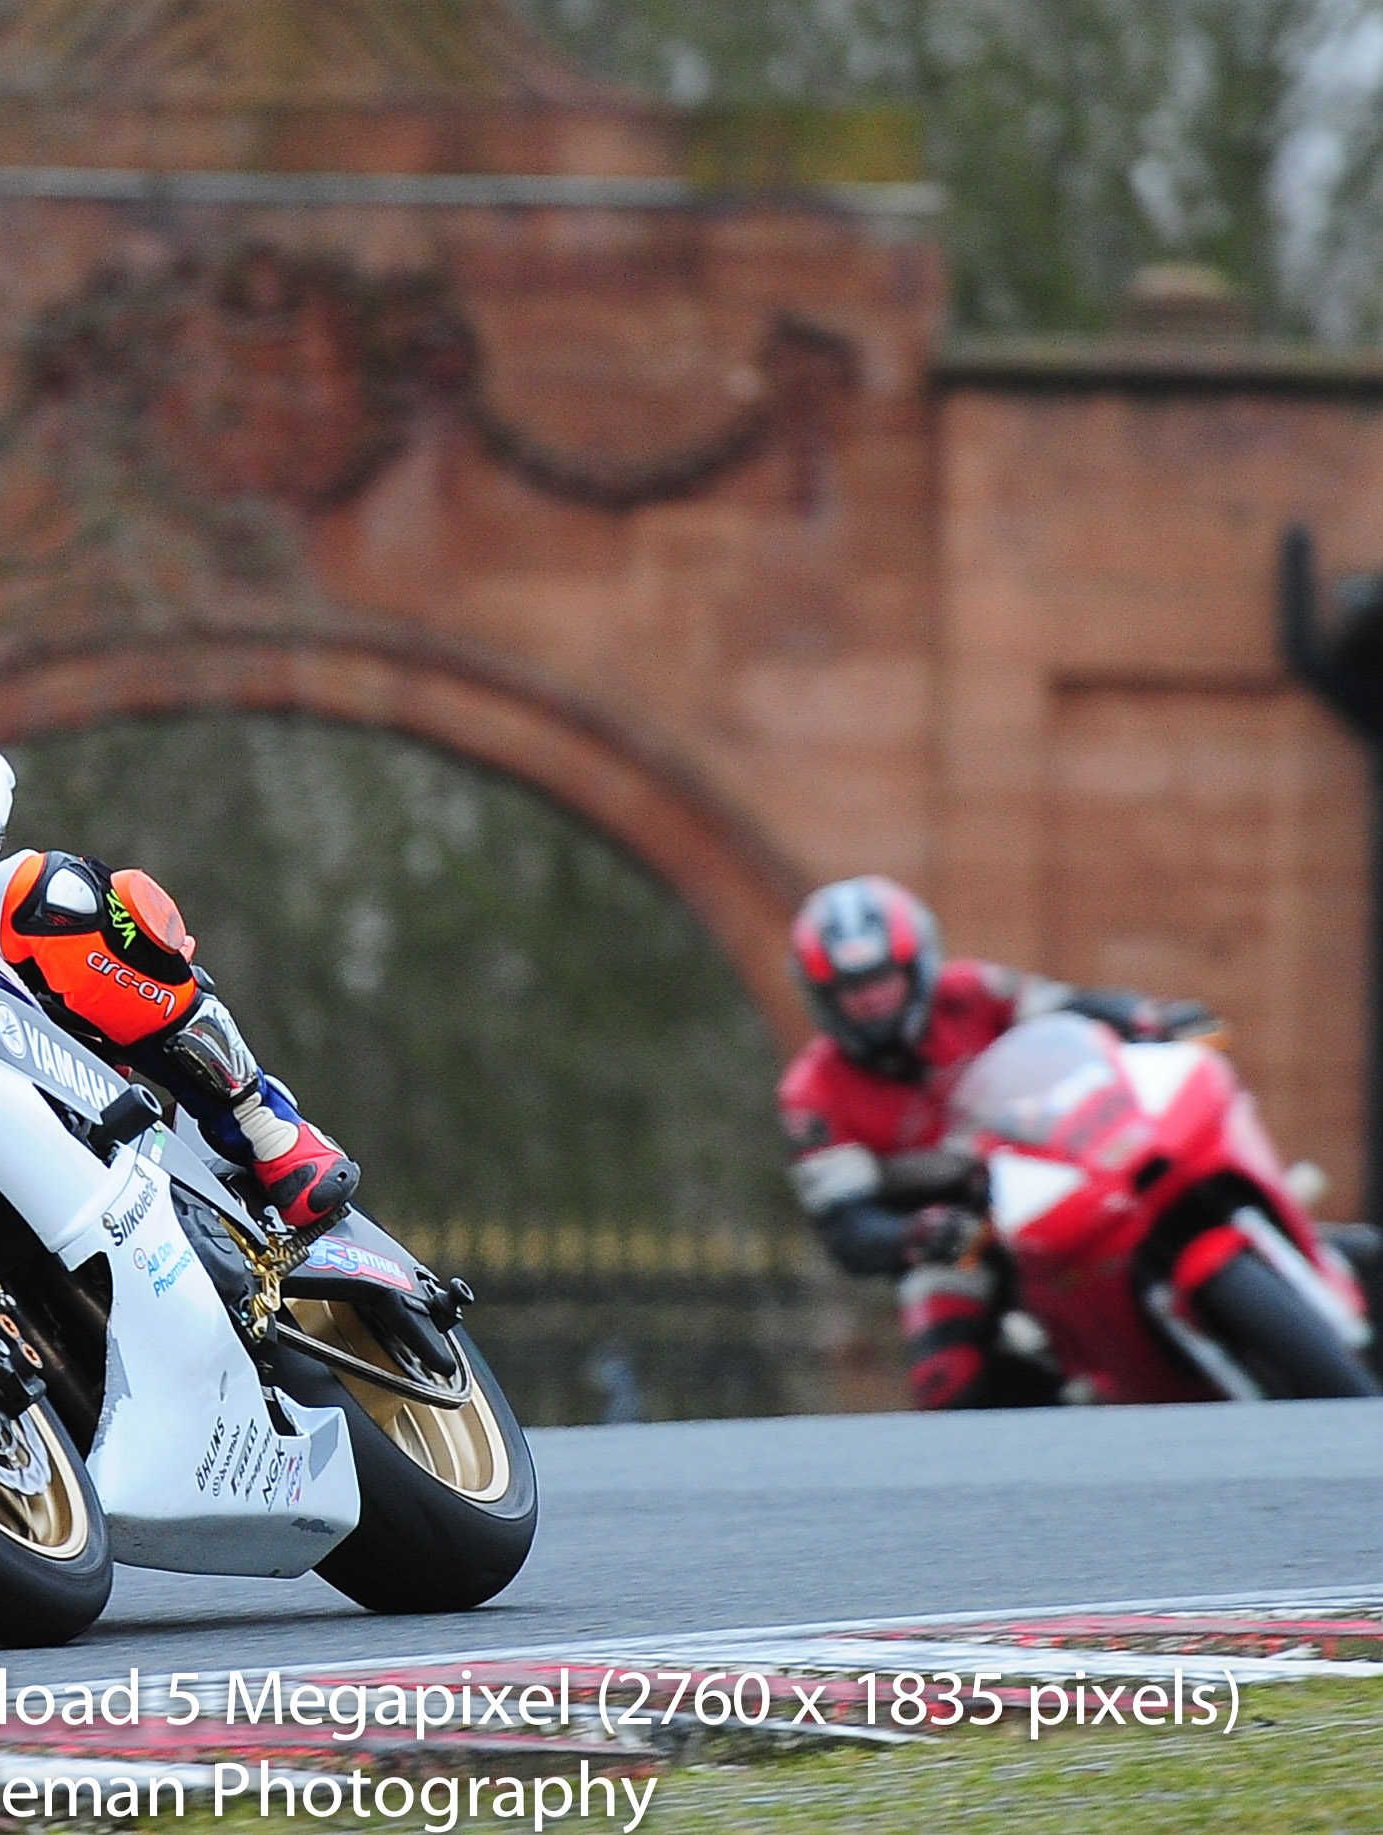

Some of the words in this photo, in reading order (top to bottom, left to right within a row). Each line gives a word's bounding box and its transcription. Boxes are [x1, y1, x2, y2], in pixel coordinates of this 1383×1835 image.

[86, 951, 176, 1019] arc-on
[146, 1251, 161, 1278] All
[153, 1248, 196, 1298] Pharmacy
[262, 1440, 285, 1504] NGK
